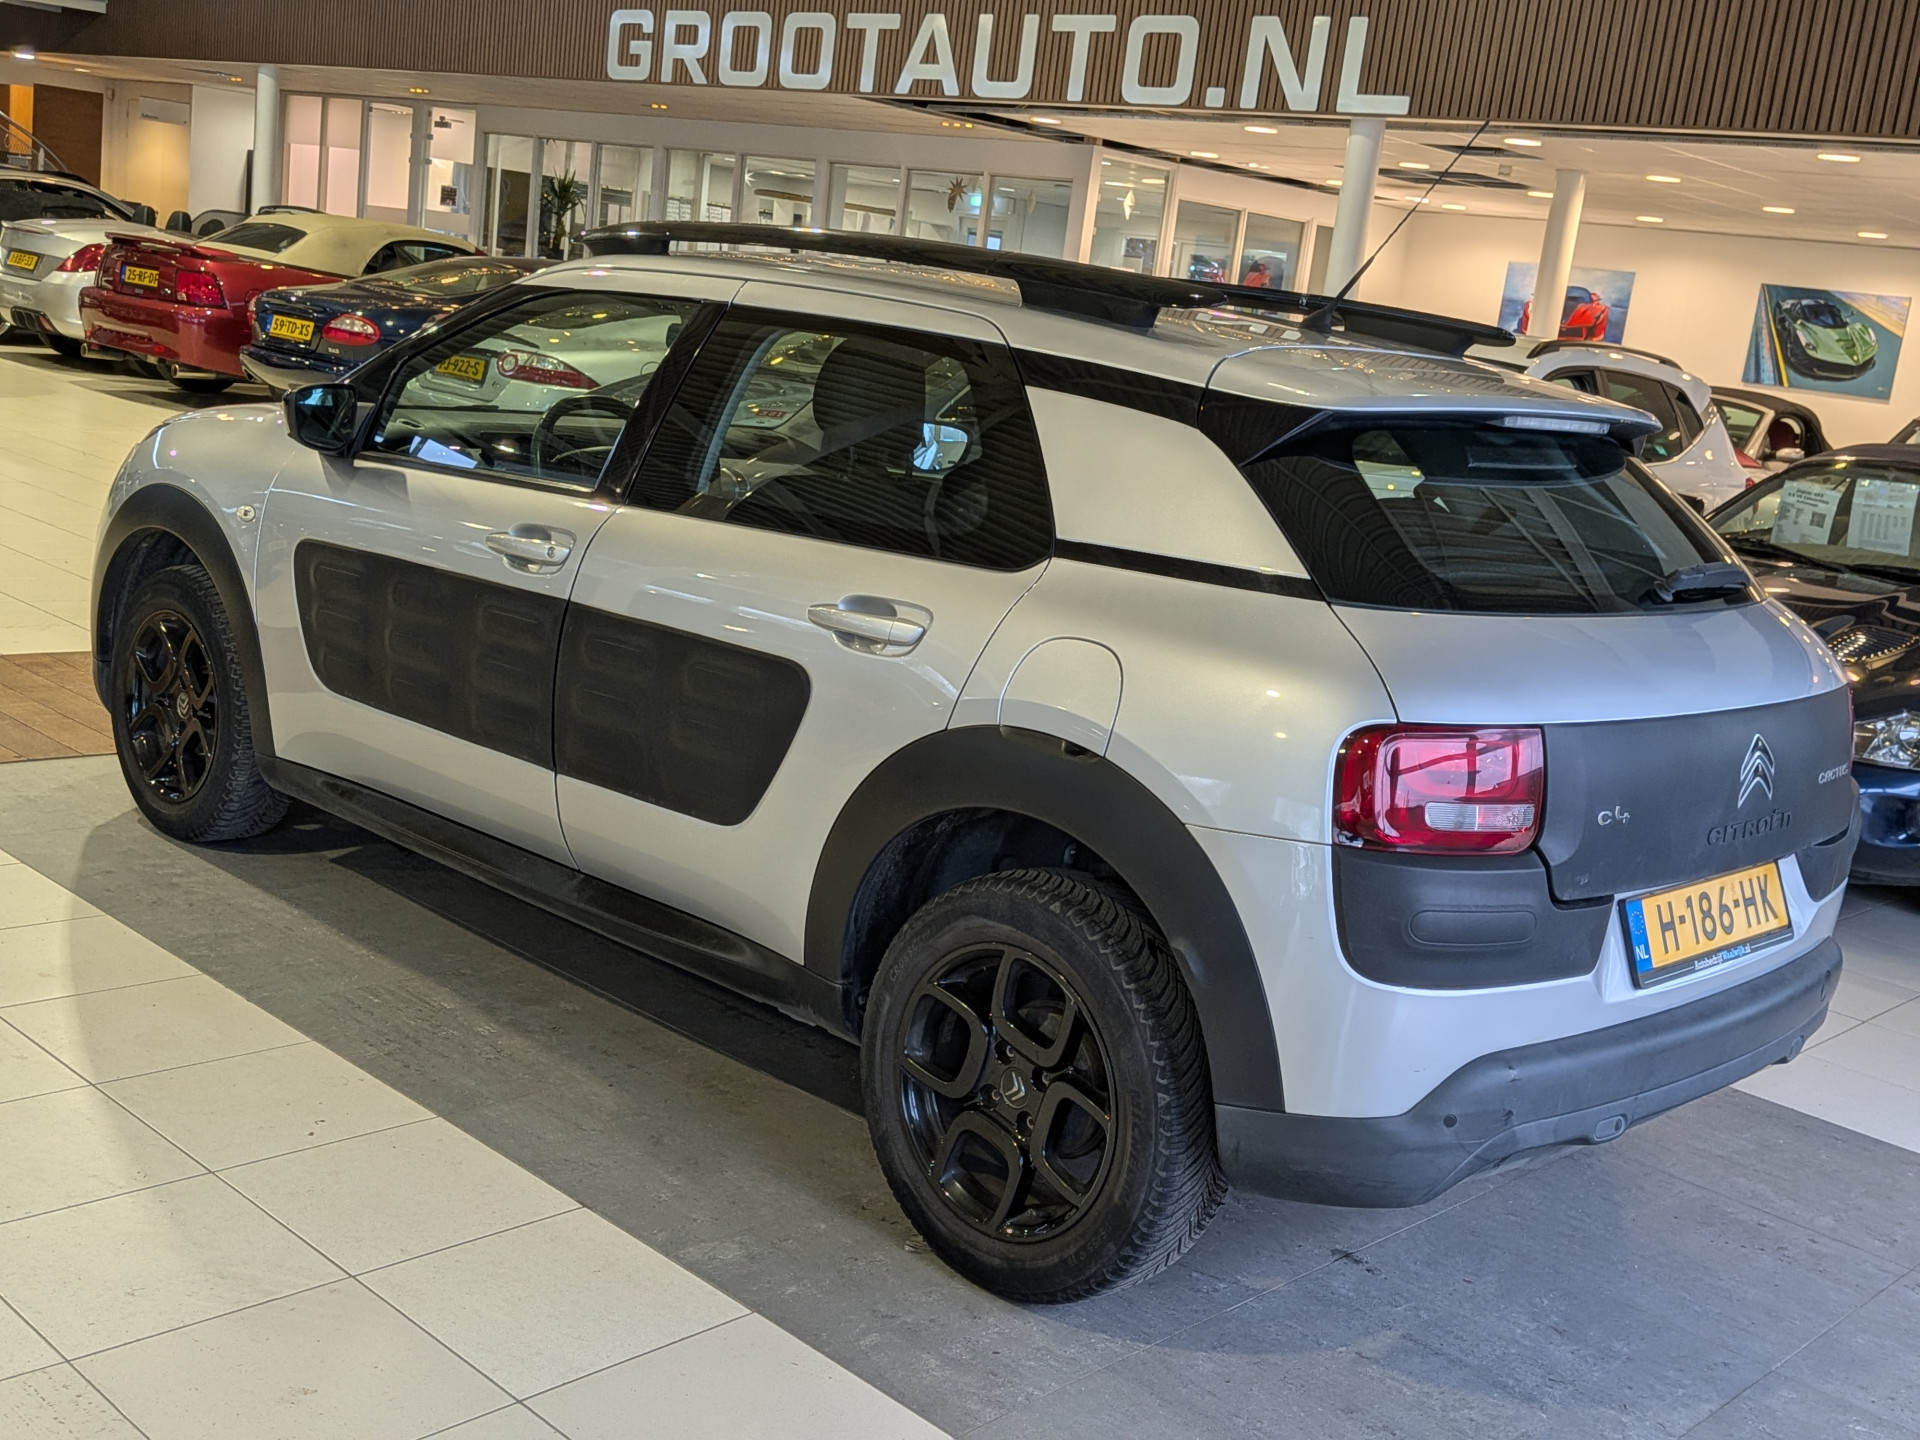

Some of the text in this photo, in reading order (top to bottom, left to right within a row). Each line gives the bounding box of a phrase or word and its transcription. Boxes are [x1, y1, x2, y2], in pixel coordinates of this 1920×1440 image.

[607, 9, 1410, 115] GROOTAUTO.NL
[273, 318, 311, 337] 59-TD-XS
[1656, 873, 1779, 955] H-186-HK
[1635, 943, 1650, 961] NL
